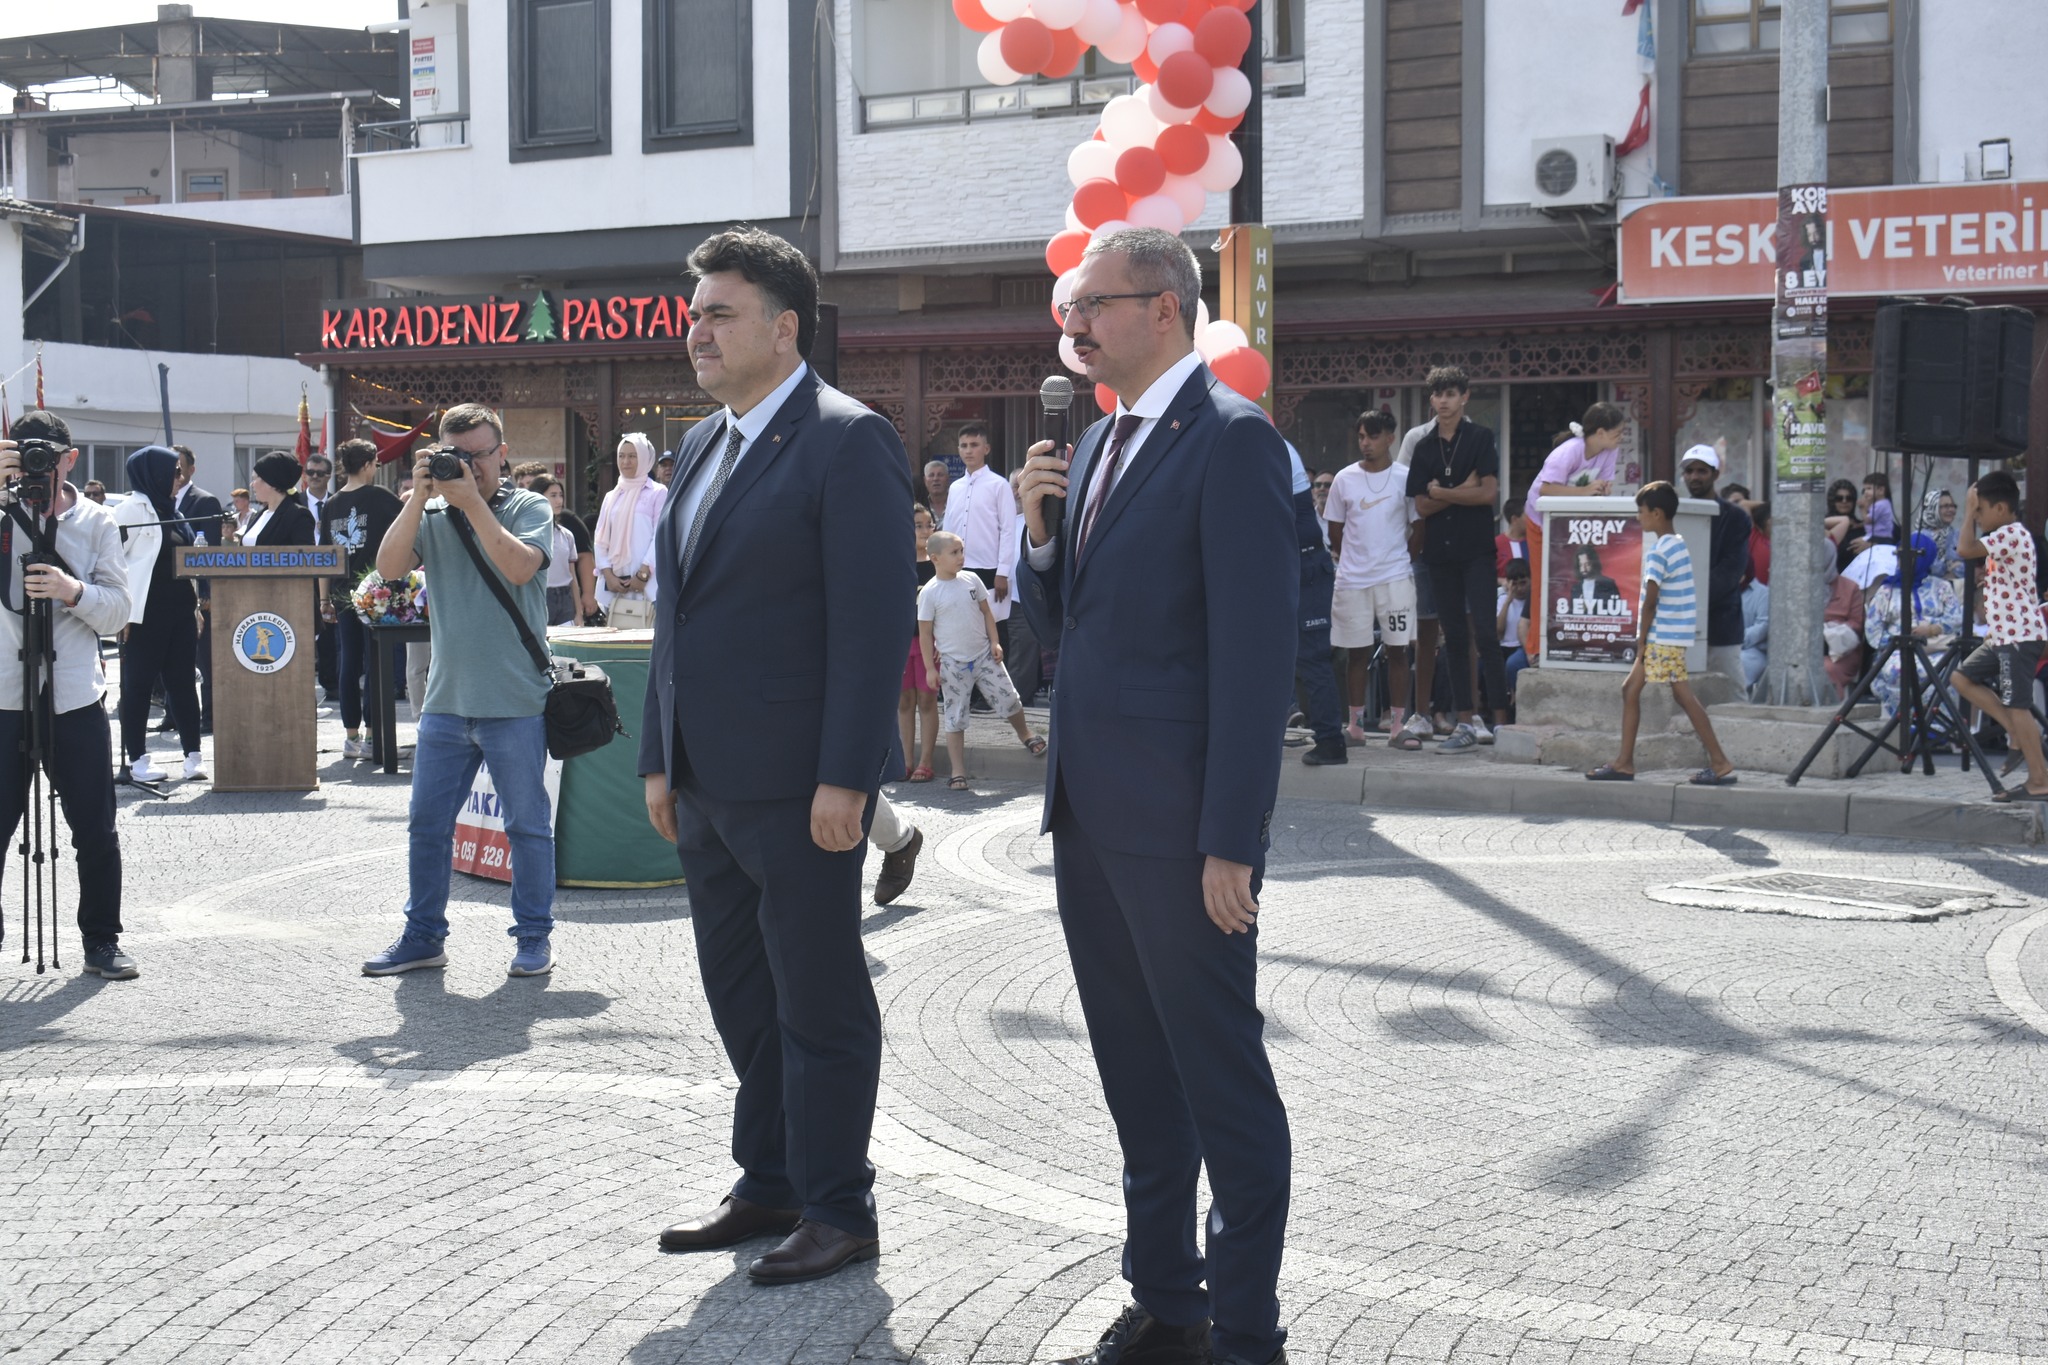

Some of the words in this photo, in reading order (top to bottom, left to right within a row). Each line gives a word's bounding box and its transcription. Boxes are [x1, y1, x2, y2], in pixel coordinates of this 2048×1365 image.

[1650, 219, 1834, 268] KESK
[1848, 197, 2048, 260] VETERİ
[1785, 271, 1799, 289] 8
[1942, 263, 2038, 282] Veteriner
[322, 295, 519, 349] KARADENİZ
[1568, 519, 1626, 534] KORAY
[1567, 531, 1608, 546] AVCI
[185, 553, 247, 568] HAVRAN
[251, 549, 337, 567] BELEDİYESİ
[1556, 597, 1569, 615] 8
[1572, 594, 1632, 616] EYLÜL
[235, 617, 257, 645] HAVRAN
[257, 614, 294, 644] BELEDİYESİ
[1388, 614, 1407, 632] 95
[255, 664, 275, 672] 1923
[480, 845, 504, 868] 328
